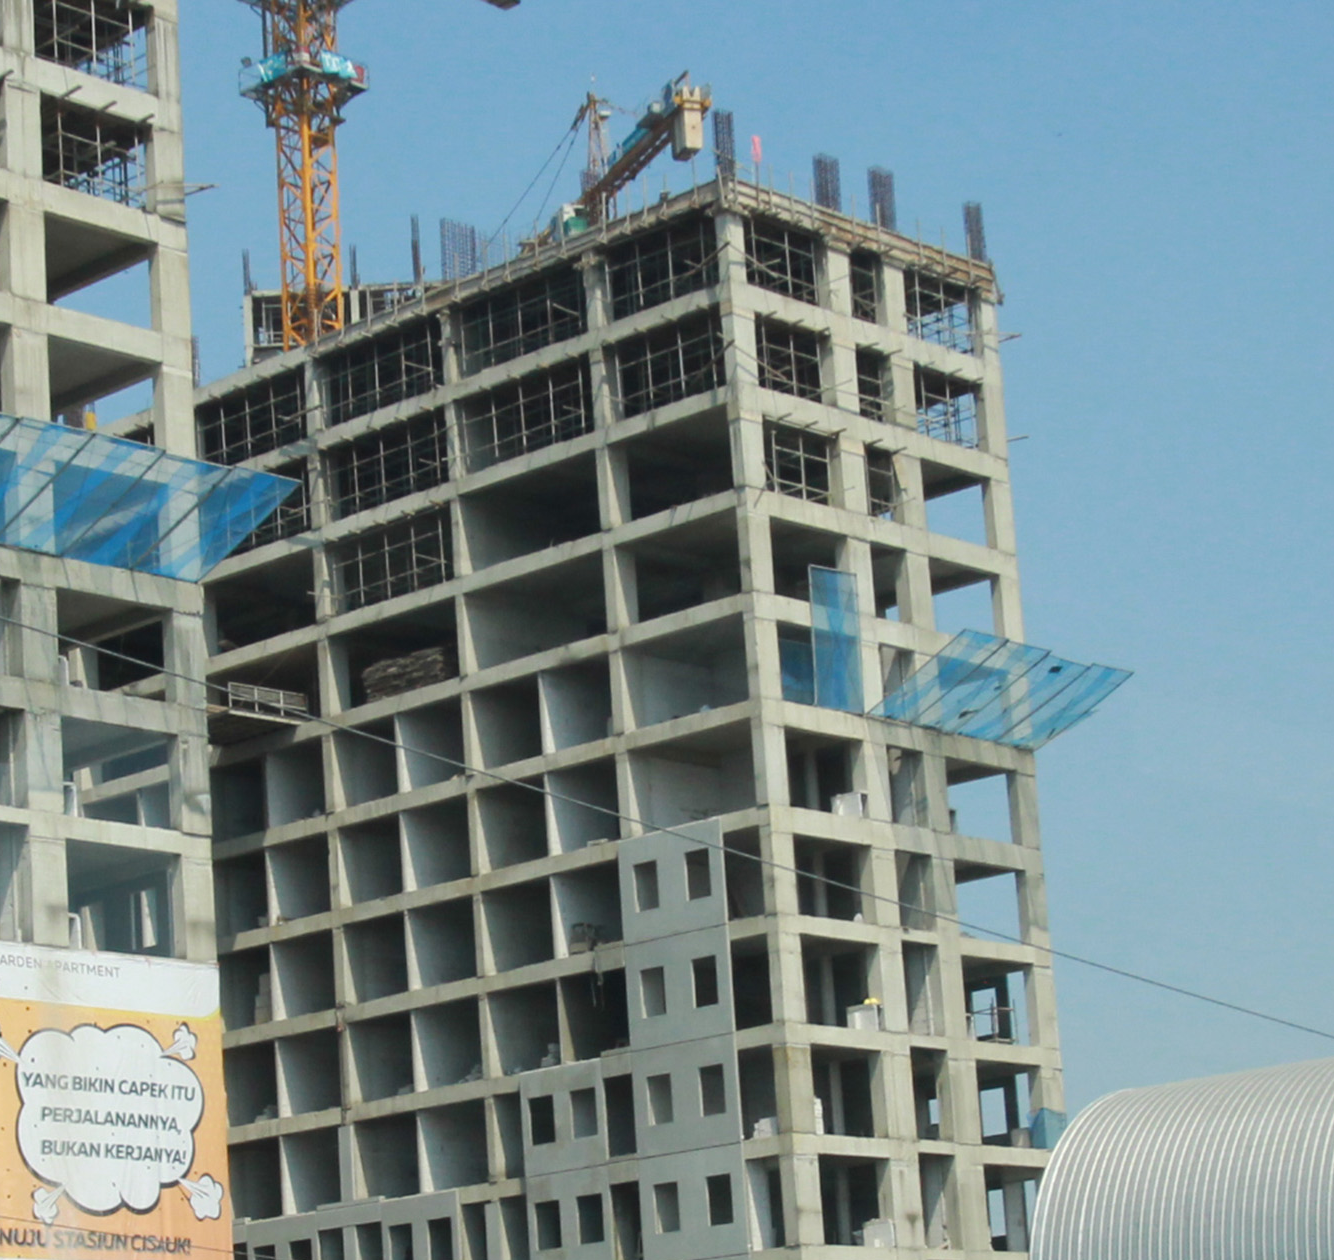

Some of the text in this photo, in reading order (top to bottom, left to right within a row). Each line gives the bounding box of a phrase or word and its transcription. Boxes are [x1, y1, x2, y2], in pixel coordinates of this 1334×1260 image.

[22, 1071, 196, 1102] YANG BIKIN CAPEK ITU
[41, 1106, 182, 1135] PERJALANANNYA,
[41, 1139, 187, 1165] BUKAN KERJANYA!
[52, 1230, 127, 1250] STASIUN
[130, 1233, 191, 1256] CISAUK!
